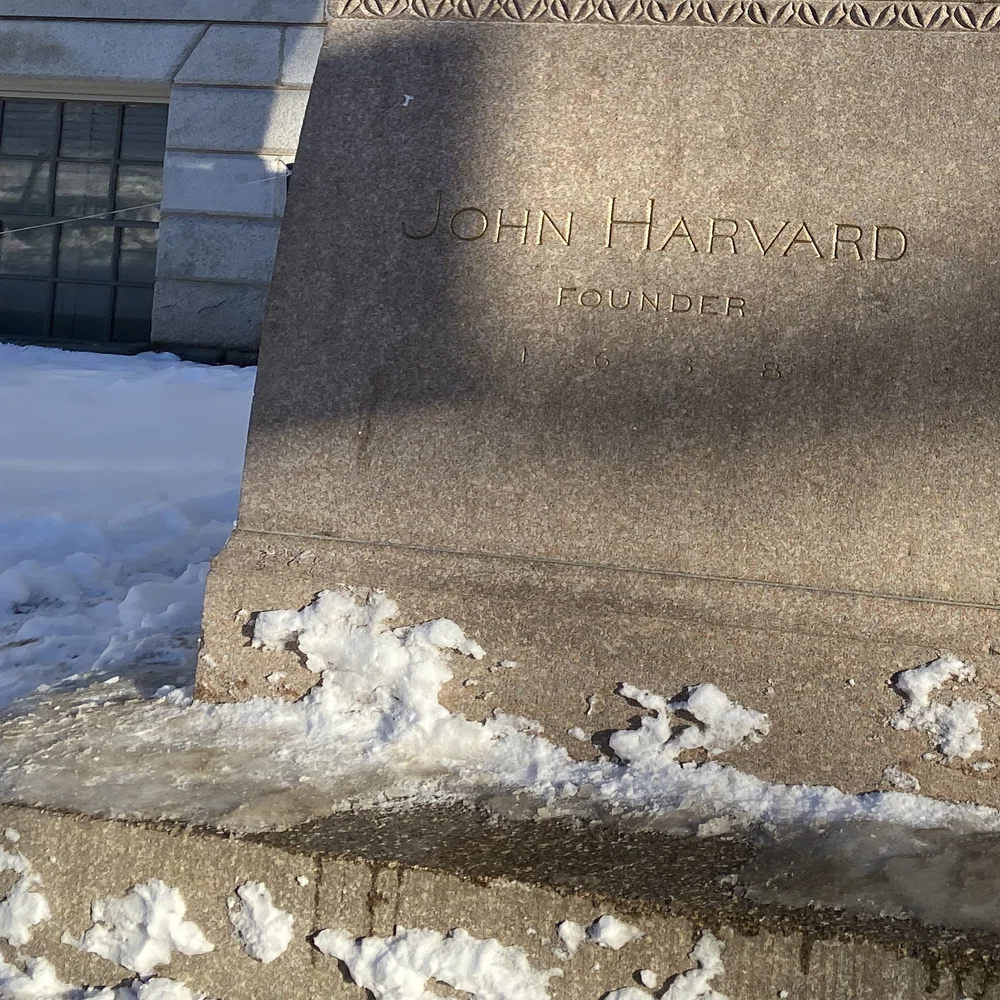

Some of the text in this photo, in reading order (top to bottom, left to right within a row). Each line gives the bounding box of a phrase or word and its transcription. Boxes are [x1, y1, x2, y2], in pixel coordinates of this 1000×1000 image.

[402, 189, 908, 262] JOHN HARVARD
[556, 286, 747, 318] FOUNDER
